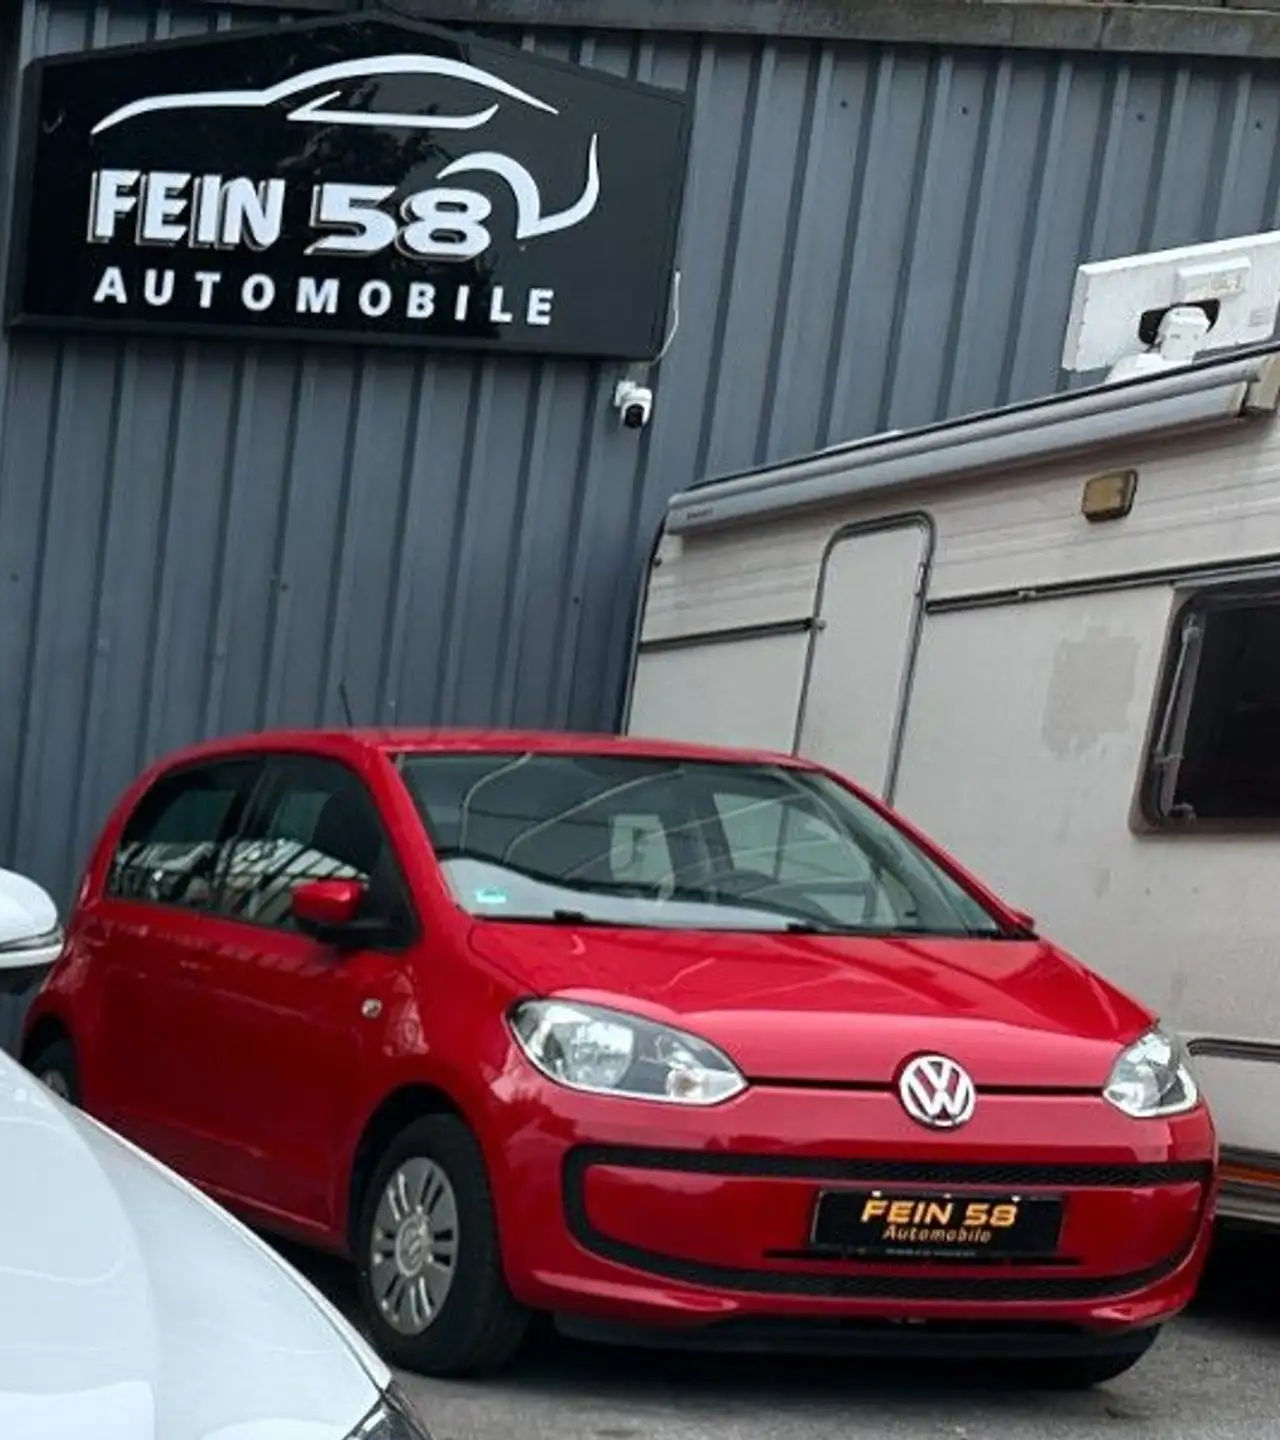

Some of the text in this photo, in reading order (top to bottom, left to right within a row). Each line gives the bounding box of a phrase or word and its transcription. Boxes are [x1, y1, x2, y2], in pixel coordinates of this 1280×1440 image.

[88, 169, 492, 262] FEIN 58
[93, 265, 554, 325] AUTOMOBILE
[860, 1199, 1018, 1227] FEIN 58
[882, 1224, 992, 1244] Automobile
